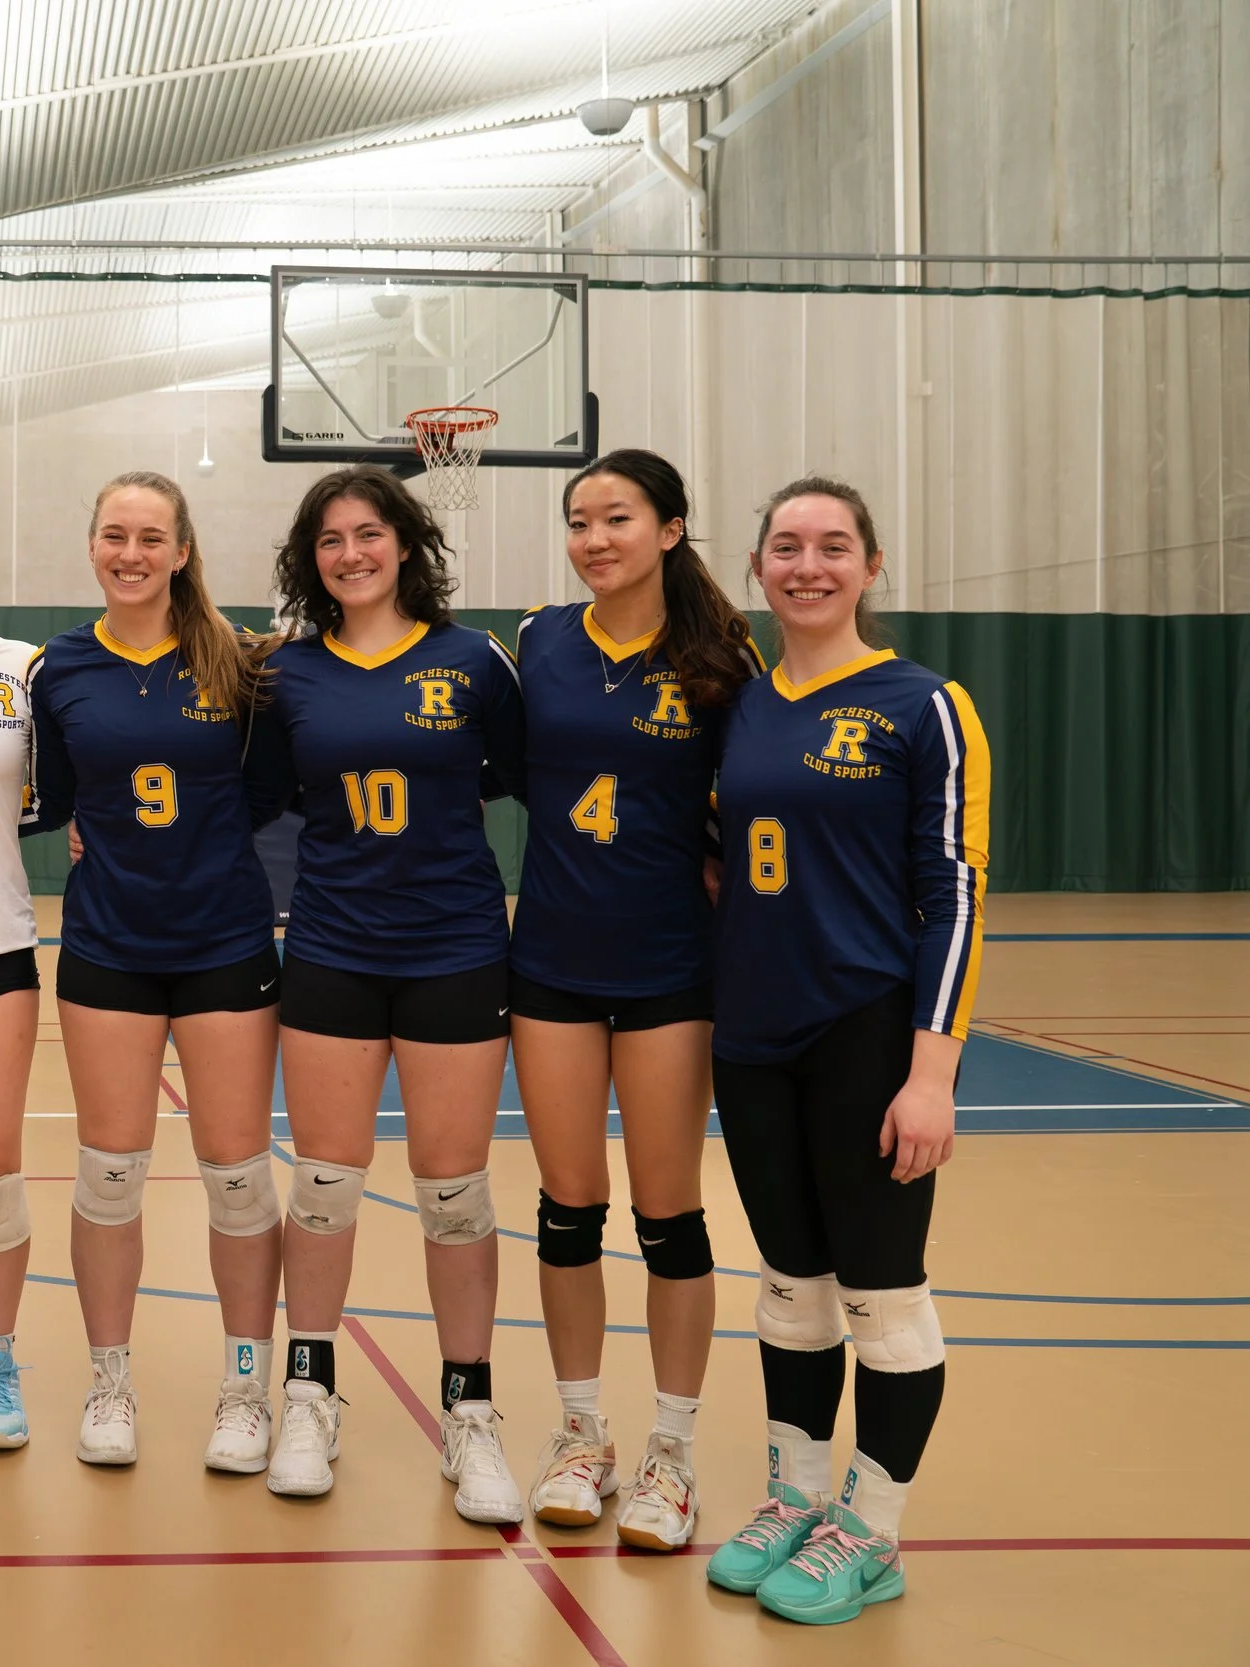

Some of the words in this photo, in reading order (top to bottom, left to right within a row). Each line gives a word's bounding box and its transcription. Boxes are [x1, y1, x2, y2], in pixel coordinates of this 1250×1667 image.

[404, 668, 470, 688] ROCHESTER
[181, 706, 207, 721] CLUB
[419, 680, 456, 717] R
[649, 682, 693, 727] R
[404, 712, 433, 730] CLUB
[632, 716, 659, 736] CLUB
[819, 707, 895, 735] ROCHESTER
[820, 717, 870, 765] R
[803, 752, 830, 774] CLUB
[834, 764, 882, 779] SPORTS
[131, 762, 179, 828] 9
[340, 768, 408, 836] 10
[569, 773, 618, 843] 4
[748, 817, 788, 895] 8
